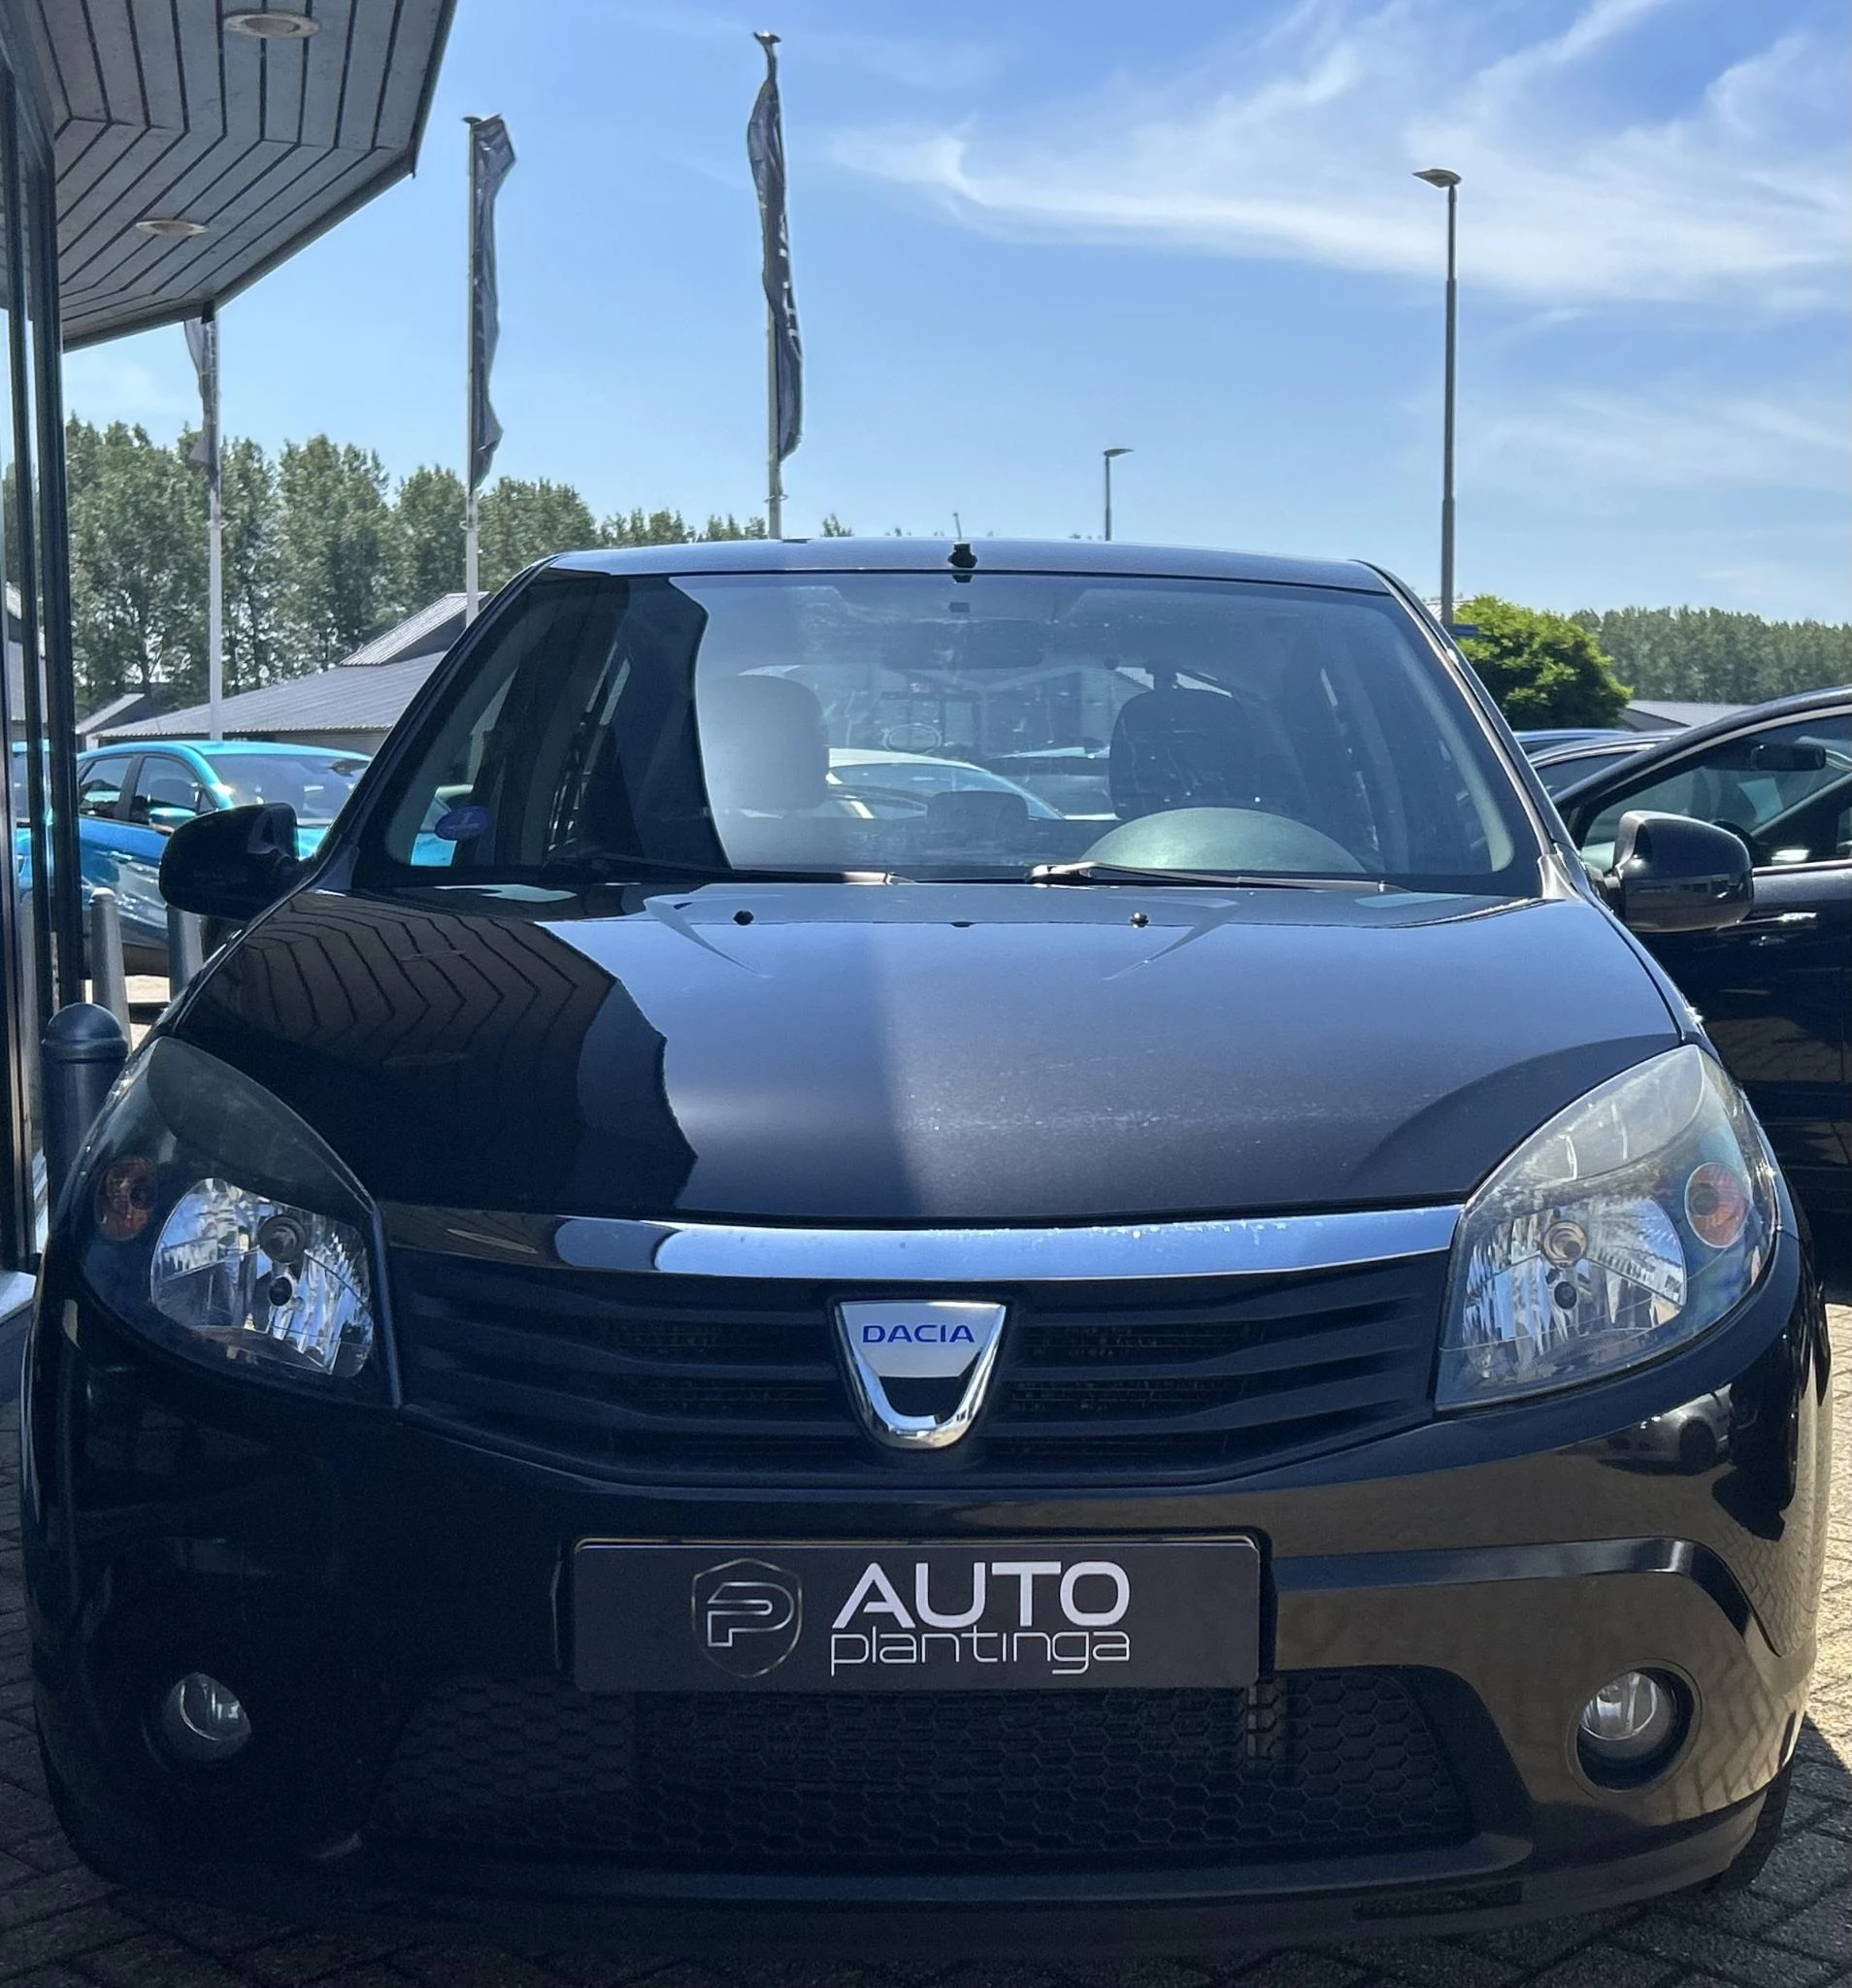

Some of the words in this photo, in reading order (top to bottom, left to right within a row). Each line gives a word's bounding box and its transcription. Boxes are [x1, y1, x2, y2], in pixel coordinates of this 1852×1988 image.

[862, 1324, 975, 1343] DACIA
[832, 1561, 1131, 1629] AUTO
[831, 1625, 1131, 1676] plantinga
